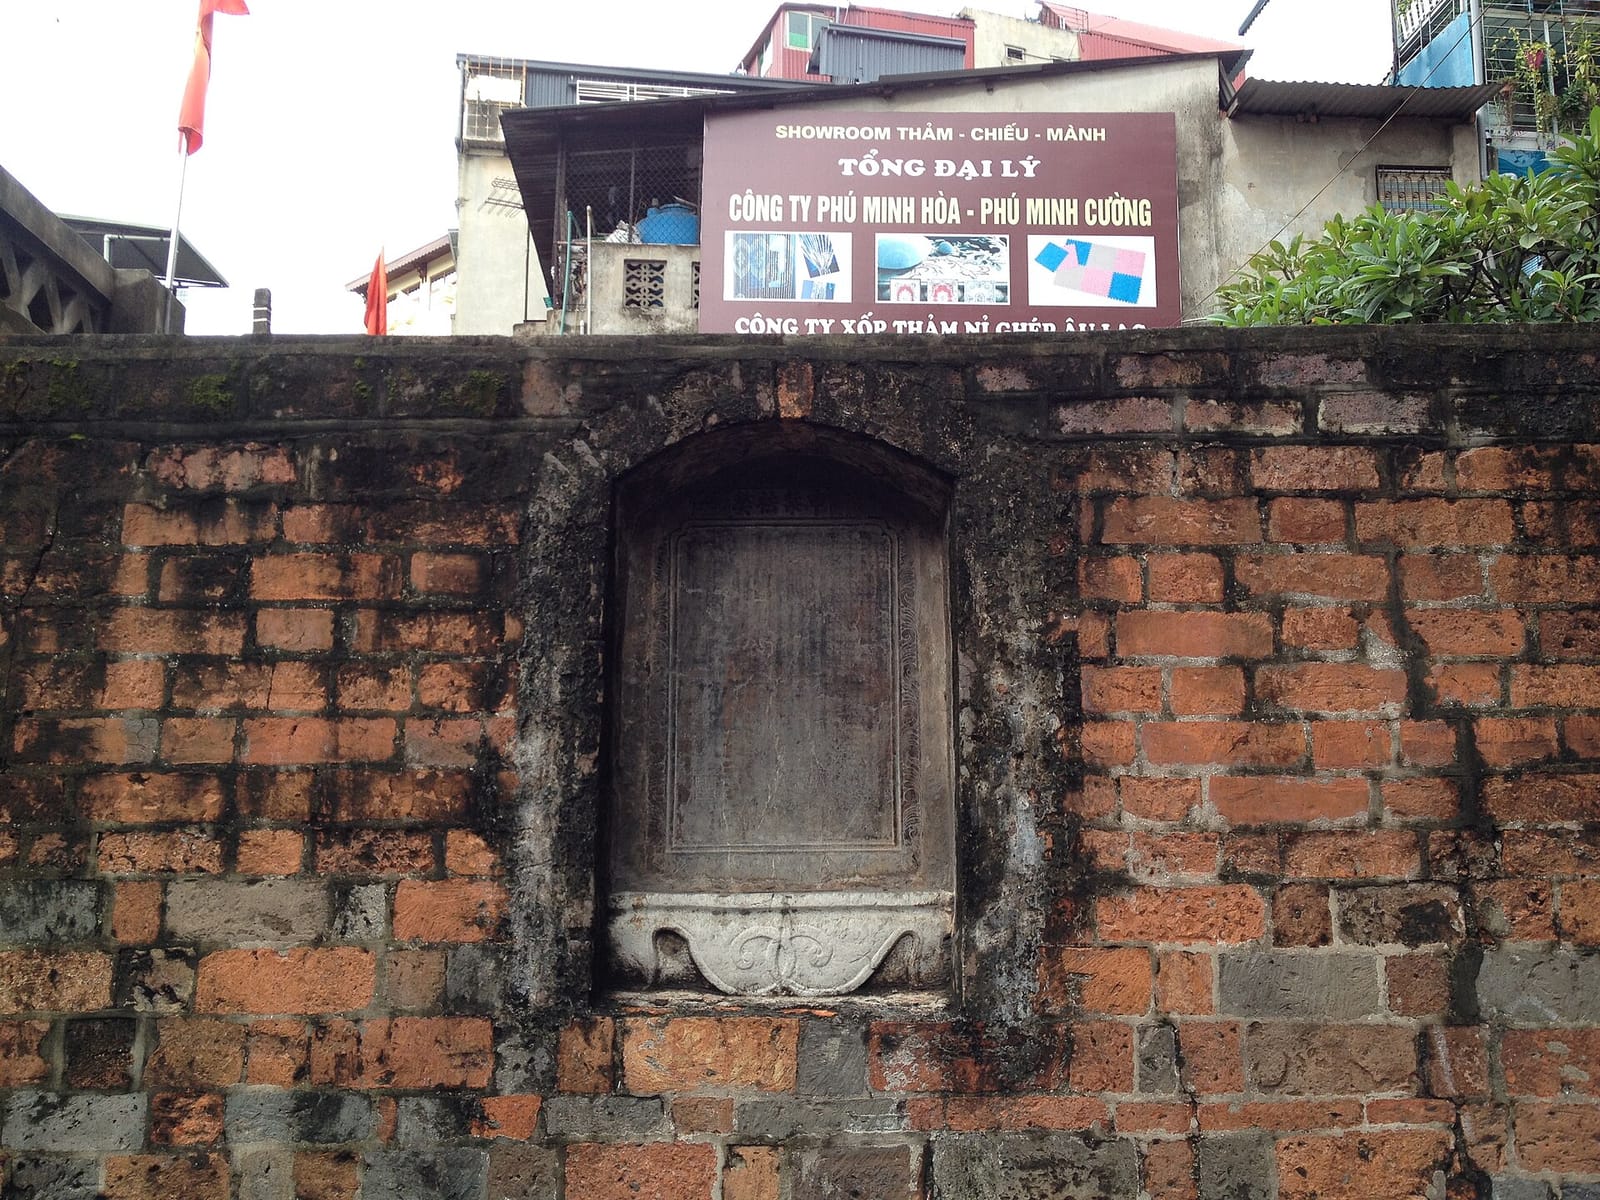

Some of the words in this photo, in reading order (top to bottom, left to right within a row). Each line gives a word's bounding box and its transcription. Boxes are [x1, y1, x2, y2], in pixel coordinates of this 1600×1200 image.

[775, 125, 891, 140] SHOWROOM
[897, 122, 953, 141] THẢM
[970, 122, 1029, 142] CHIẾU
[1046, 124, 1106, 142] MÀNH
[838, 148, 926, 177] TỔNG
[933, 159, 993, 181] ĐẠI
[1000, 155, 1041, 178] LÝ
[728, 188, 783, 222] CÔNG
[788, 195, 812, 223] TY
[817, 190, 857, 223] PHÚ
[862, 196, 915, 224] MINH
[921, 191, 961, 225] HÒA
[980, 192, 1020, 226] PHÚ
[1026, 197, 1079, 226] MINH
[1084, 191, 1152, 227] CƯỜNG
[734, 312, 799, 335] CÔNG
[804, 318, 835, 335] TY
[840, 311, 887, 335] XỐP
[892, 314, 958, 335] THẢM
